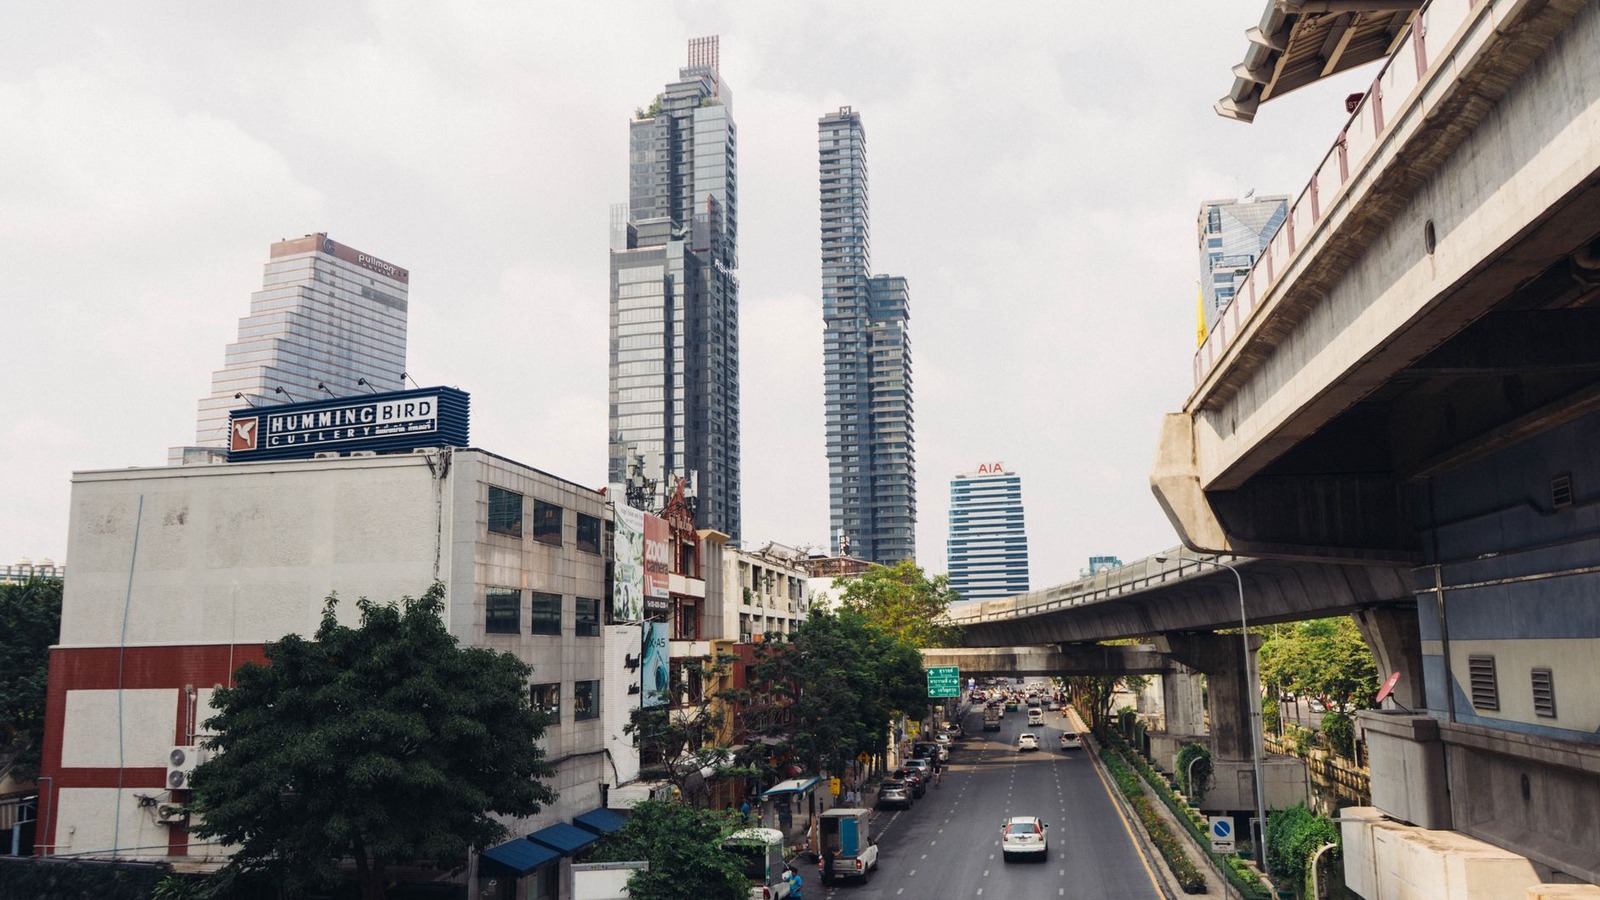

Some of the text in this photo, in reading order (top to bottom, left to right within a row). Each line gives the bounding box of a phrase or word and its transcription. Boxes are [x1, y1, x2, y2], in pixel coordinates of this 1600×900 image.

[358, 254, 395, 275] pullman
[272, 407, 373, 432] HUMMING
[382, 401, 431, 420] BIRD
[271, 427, 370, 445] CUTLERY
[978, 463, 1003, 473] AIA
[646, 539, 669, 564] ZOOM
